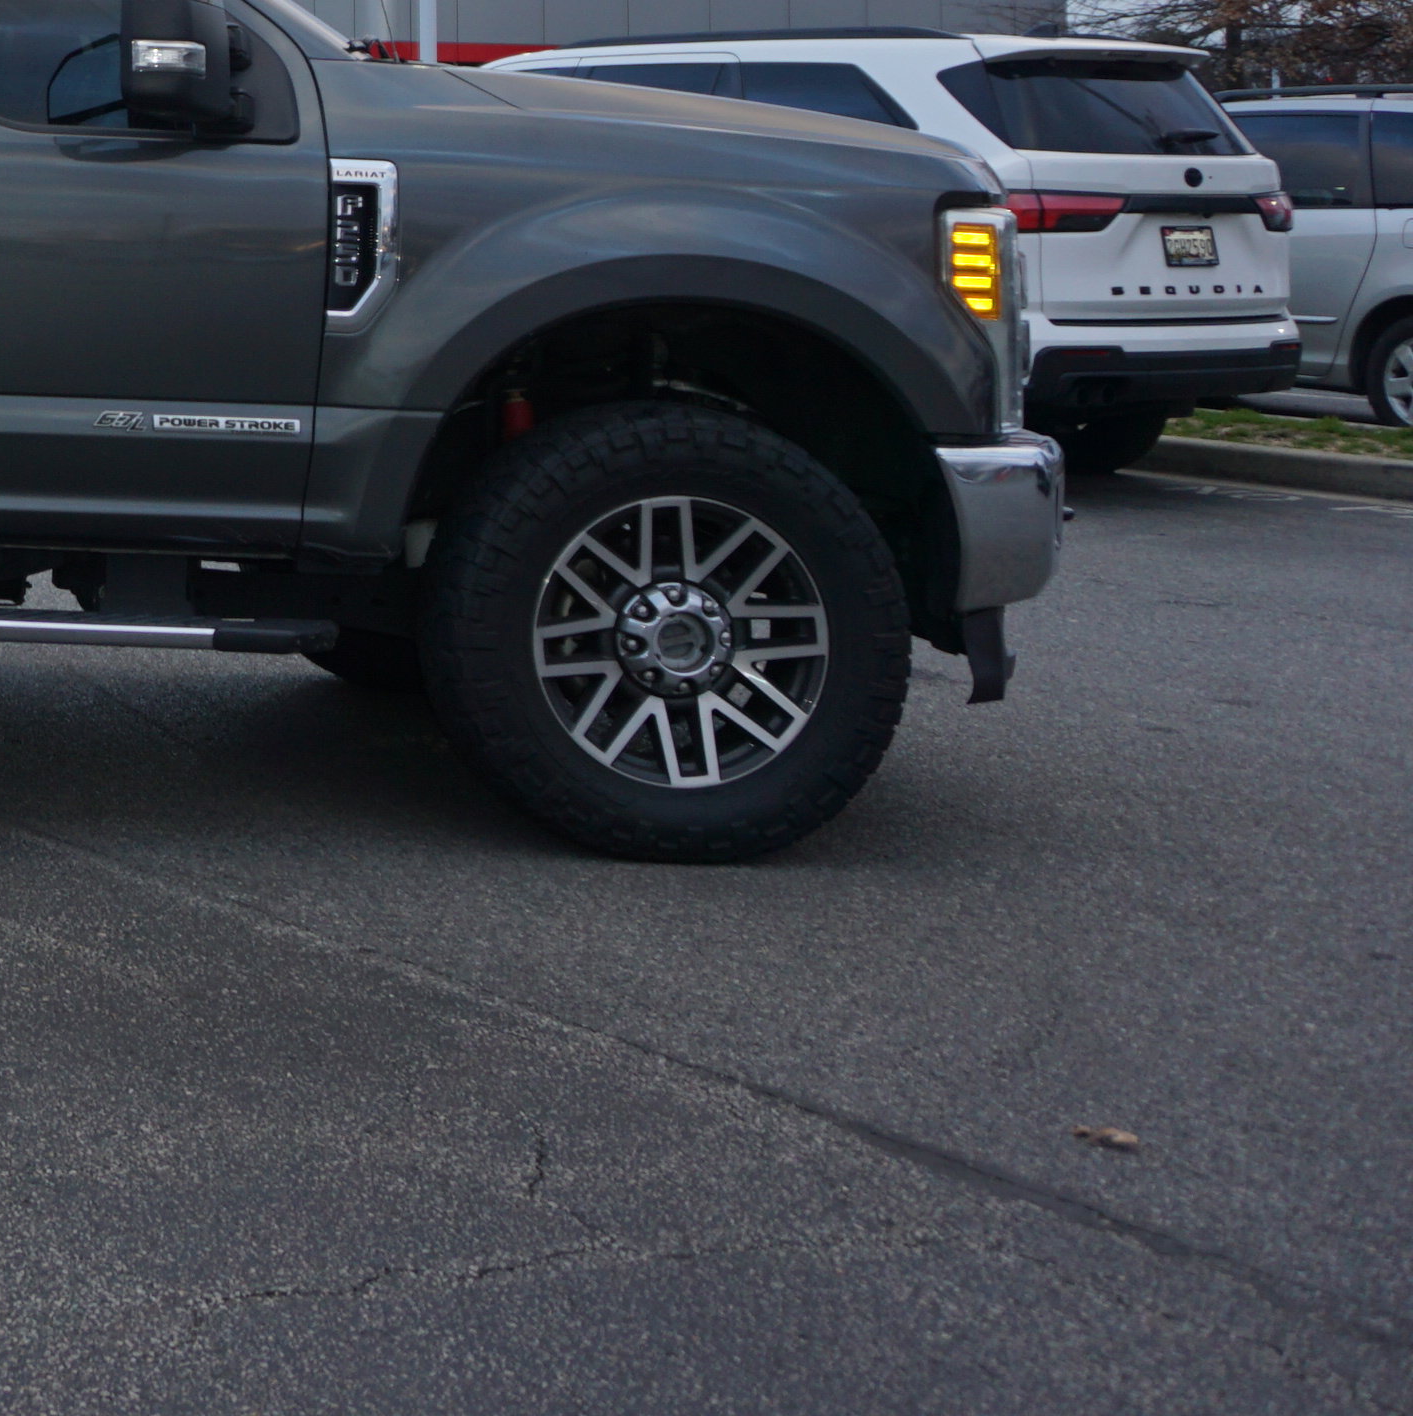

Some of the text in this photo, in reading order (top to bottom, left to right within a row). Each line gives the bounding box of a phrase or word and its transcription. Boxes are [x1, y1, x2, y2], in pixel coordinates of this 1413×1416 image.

[335, 170, 387, 179] LARIAT
[1110, 284, 1263, 296] SEQUOIA
[158, 416, 219, 428] POWER
[224, 419, 295, 431] STROKE
